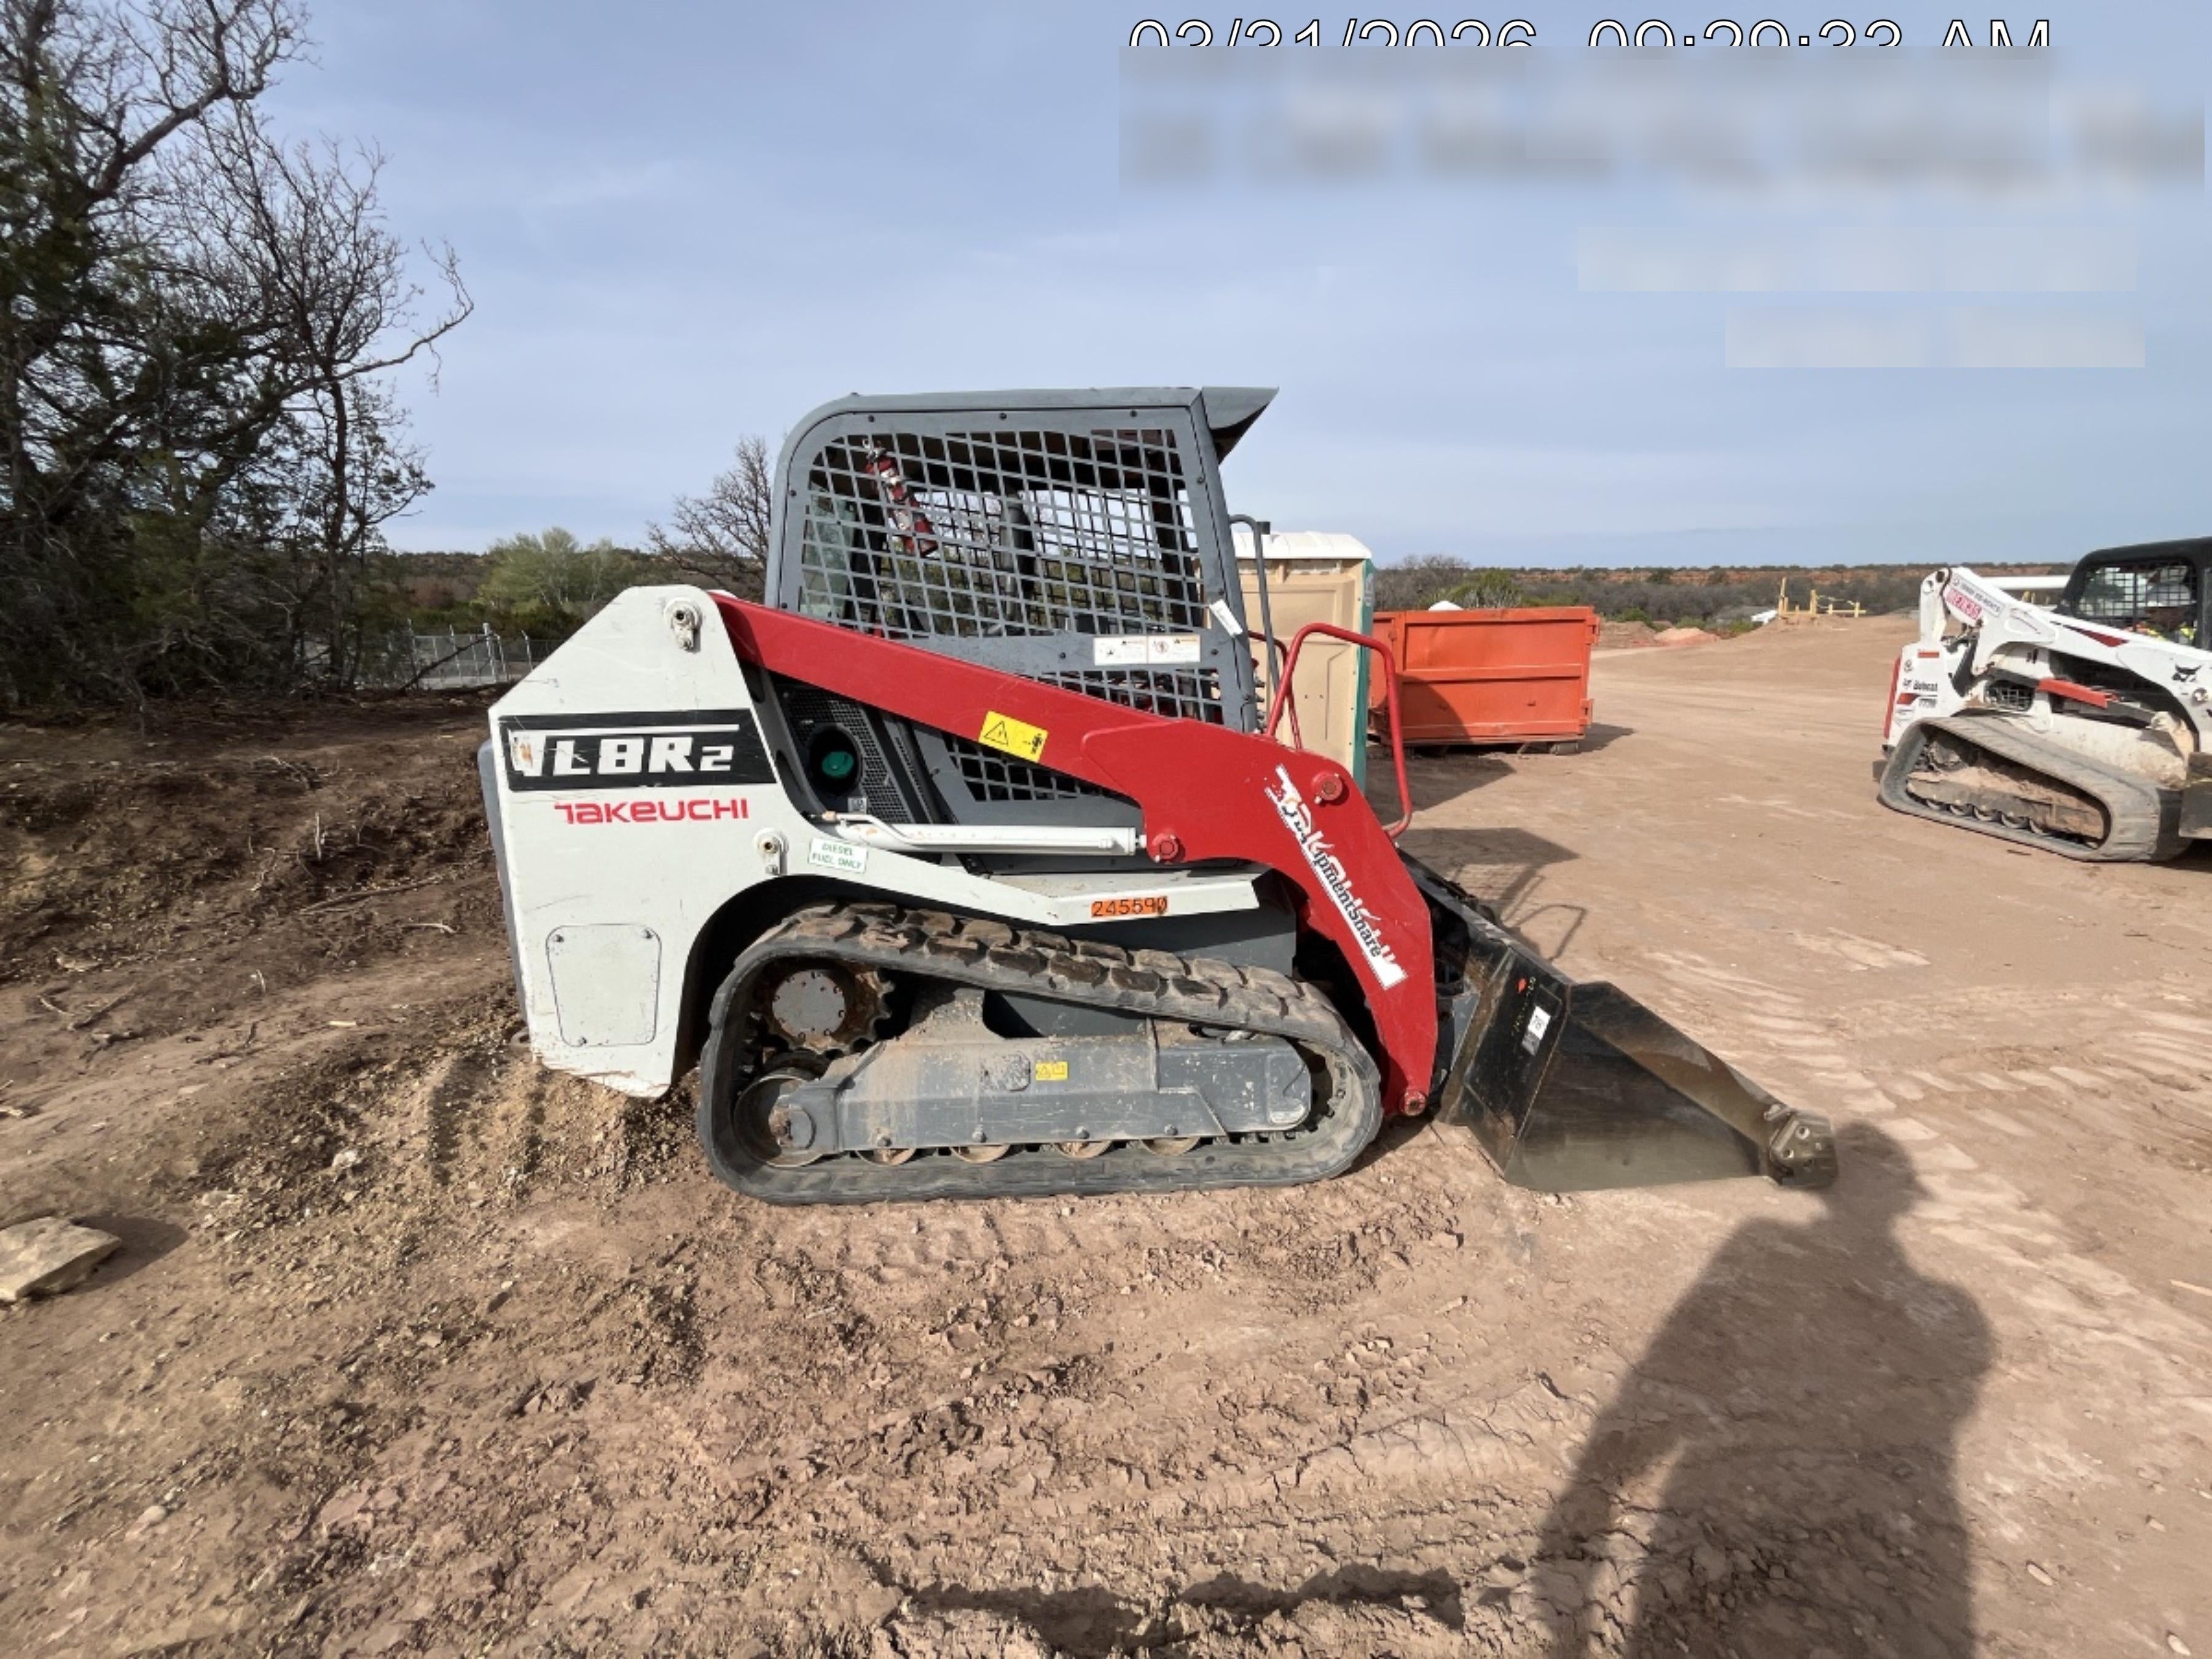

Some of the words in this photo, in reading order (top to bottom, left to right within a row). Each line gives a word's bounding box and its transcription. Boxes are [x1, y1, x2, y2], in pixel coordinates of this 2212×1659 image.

[554, 798, 749, 825] TAKEUCHI
[822, 843, 853, 856] DIESEL
[838, 857, 862, 869] ONLY
